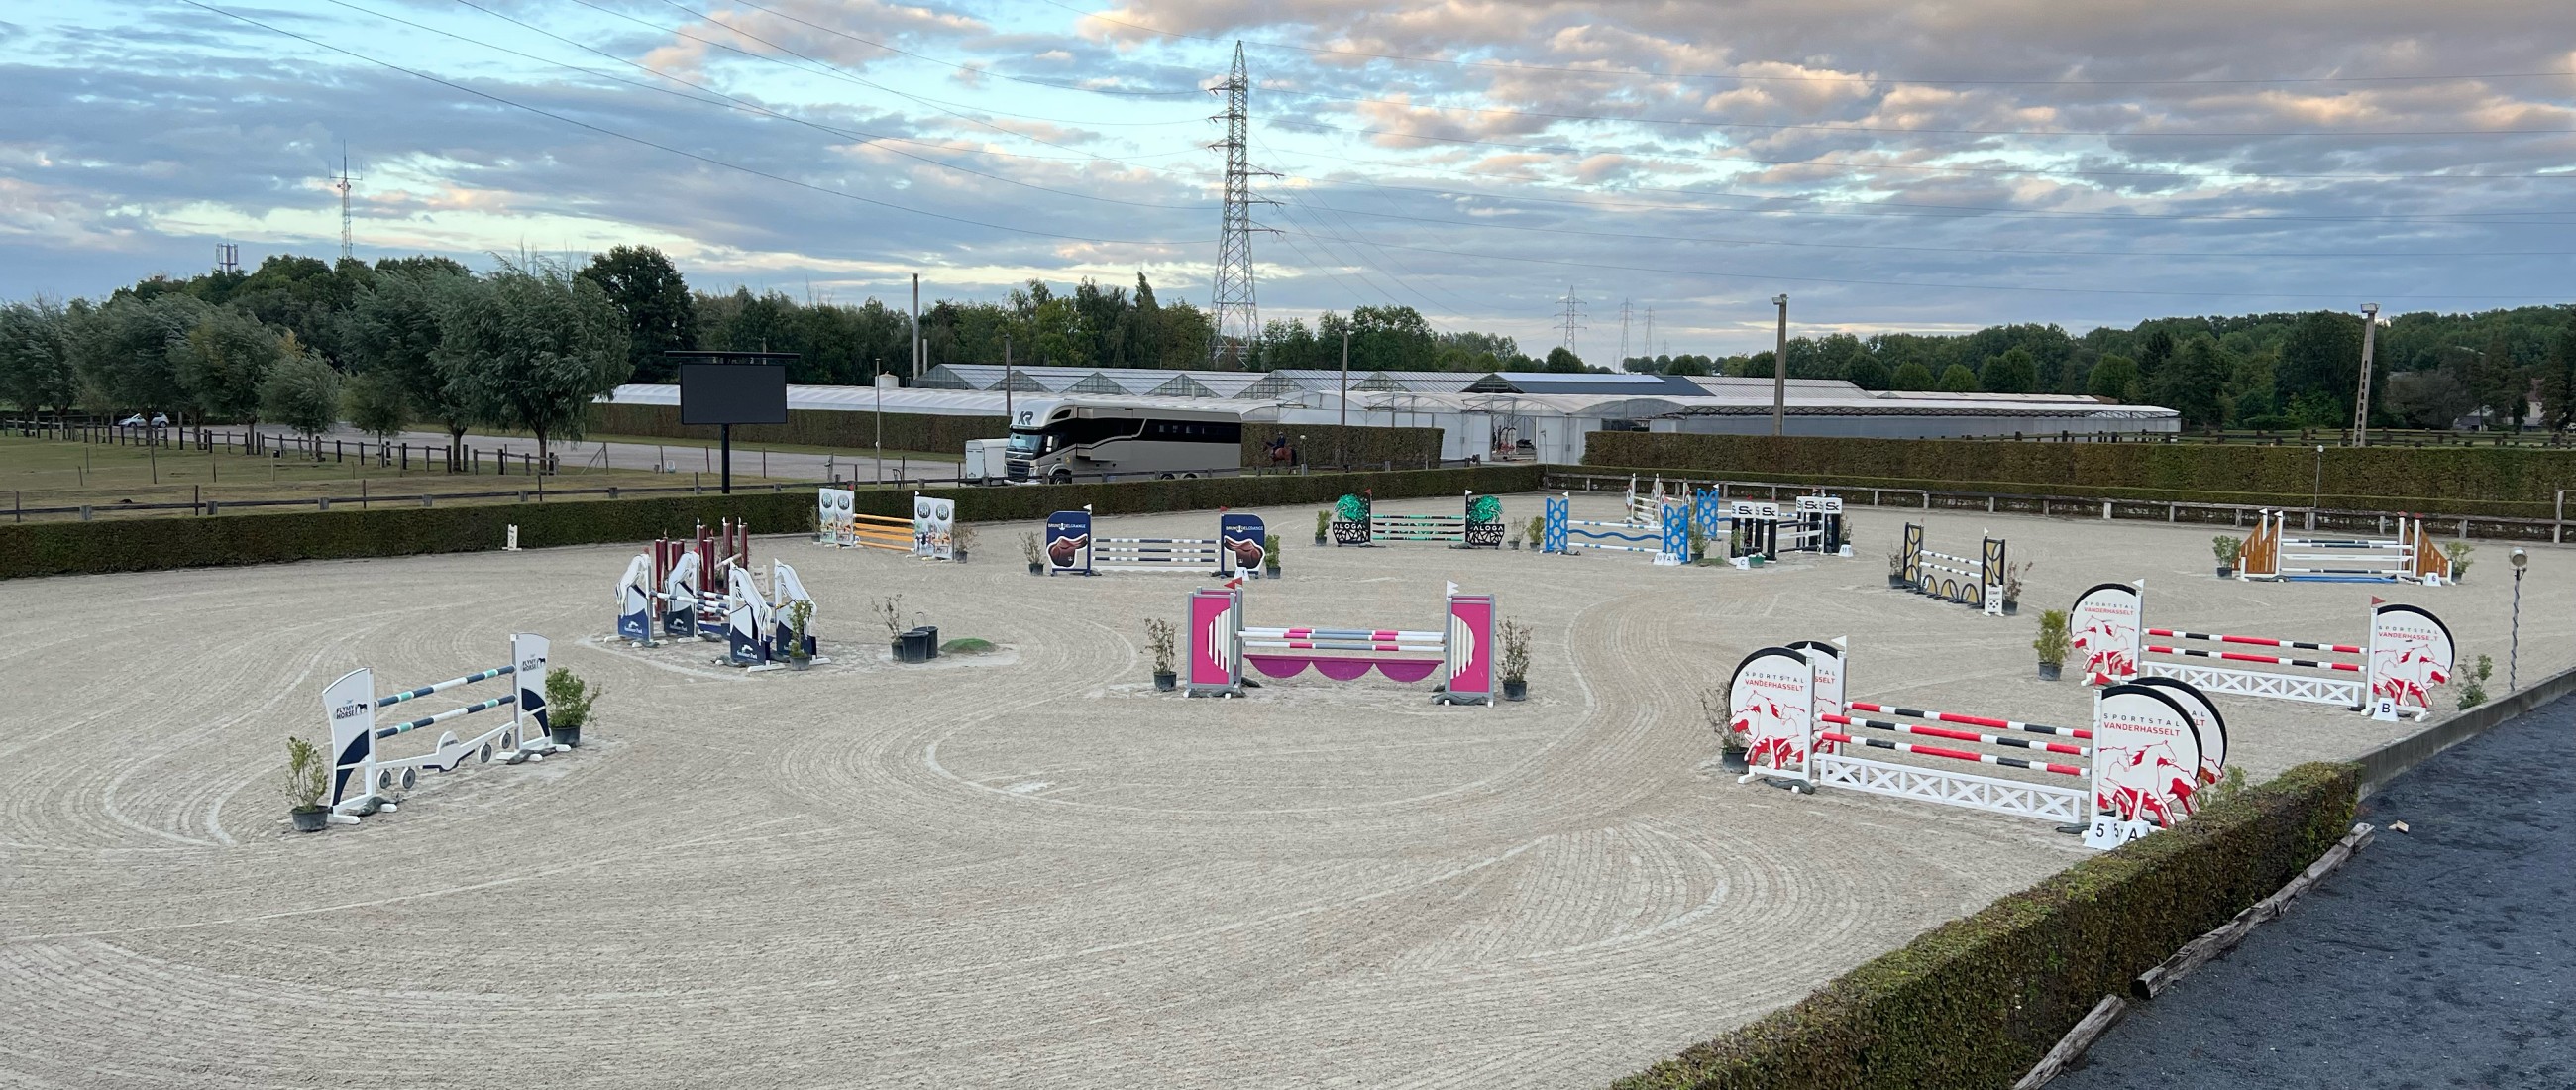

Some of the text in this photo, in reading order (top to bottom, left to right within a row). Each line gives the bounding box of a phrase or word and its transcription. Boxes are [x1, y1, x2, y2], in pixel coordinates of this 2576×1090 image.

[2084, 607, 2134, 616] VANDERHASSELT
[2085, 600, 2135, 610] SPORTSTAL
[2378, 625, 2437, 635] SPORTSTAL
[1745, 671, 1804, 684] SPORTSTAL
[1745, 679, 1804, 692] VANDERHASSELT
[2381, 703, 2391, 713] B
[2103, 712, 2180, 727] SPORTSTAL
[2103, 721, 2180, 737] VANDERHASSELT
[2095, 823, 2104, 838] 5
[2127, 827, 2138, 842] A
